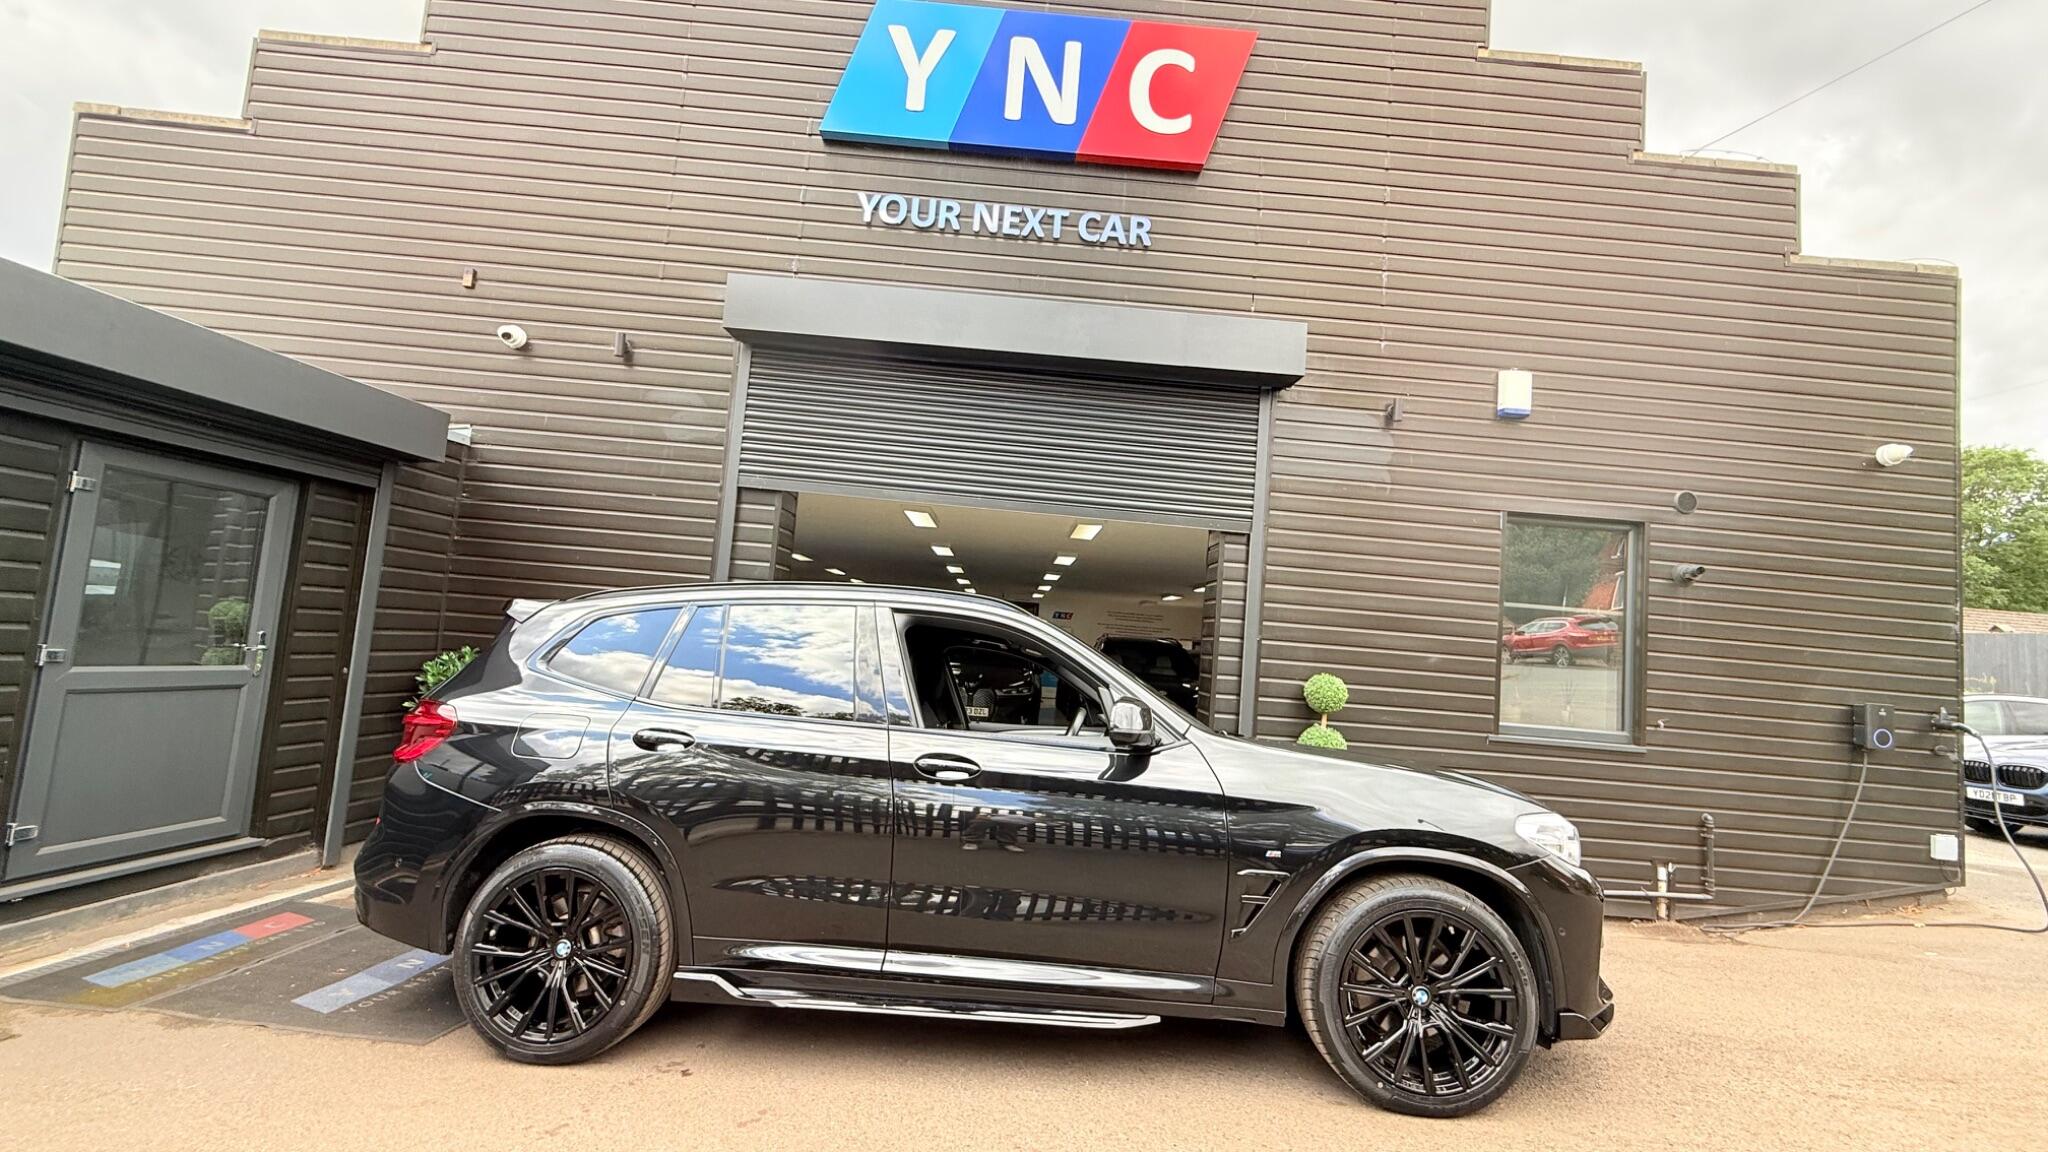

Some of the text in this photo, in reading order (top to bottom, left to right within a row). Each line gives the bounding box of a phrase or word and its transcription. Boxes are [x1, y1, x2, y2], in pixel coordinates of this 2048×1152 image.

[888, 24, 1196, 134] YNC
[857, 191, 1153, 247] YOUR NEXT CAR
